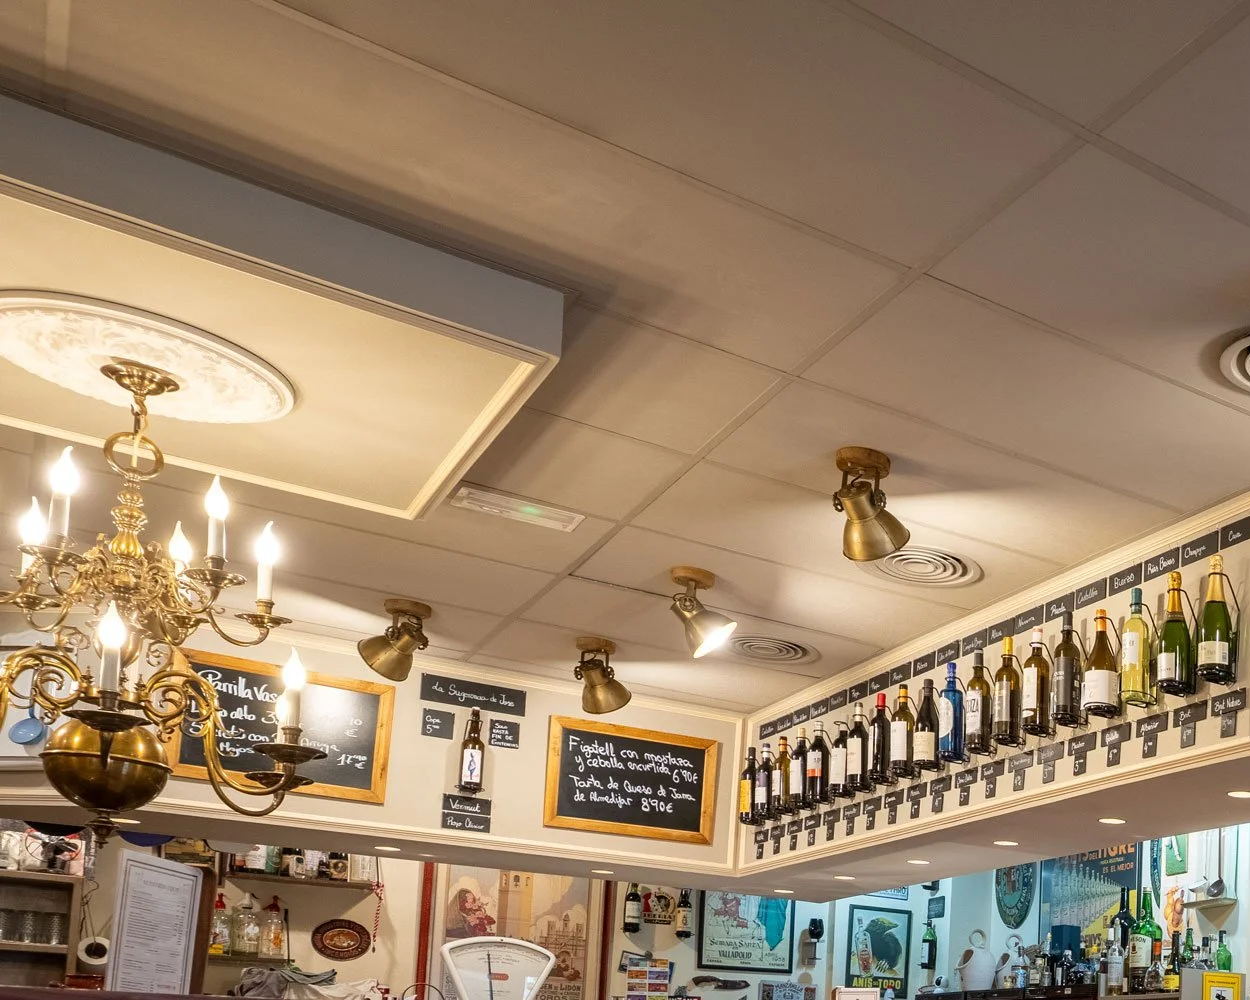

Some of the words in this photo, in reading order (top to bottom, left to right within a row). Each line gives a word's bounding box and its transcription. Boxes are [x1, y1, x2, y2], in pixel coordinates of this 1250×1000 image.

[198, 670, 252, 700] Parrilla
[249, 733, 270, 742] con
[568, 736, 616, 758] Figatell
[620, 750, 639, 760] con
[644, 752, 694, 768] mostaza
[575, 755, 584, 772] y
[587, 757, 626, 770] cebolla
[628, 760, 672, 776] encurtida
[568, 774, 604, 790] Tarta
[607, 776, 618, 790] de
[624, 780, 652, 794] Queso
[658, 784, 666, 797] de
[574, 790, 586, 802] de
[450, 798, 480, 812] Vermut
[1102, 866, 1108, 874] ES
[1117, 862, 1134, 871] MEJOR
[852, 976, 872, 988] ANIS
